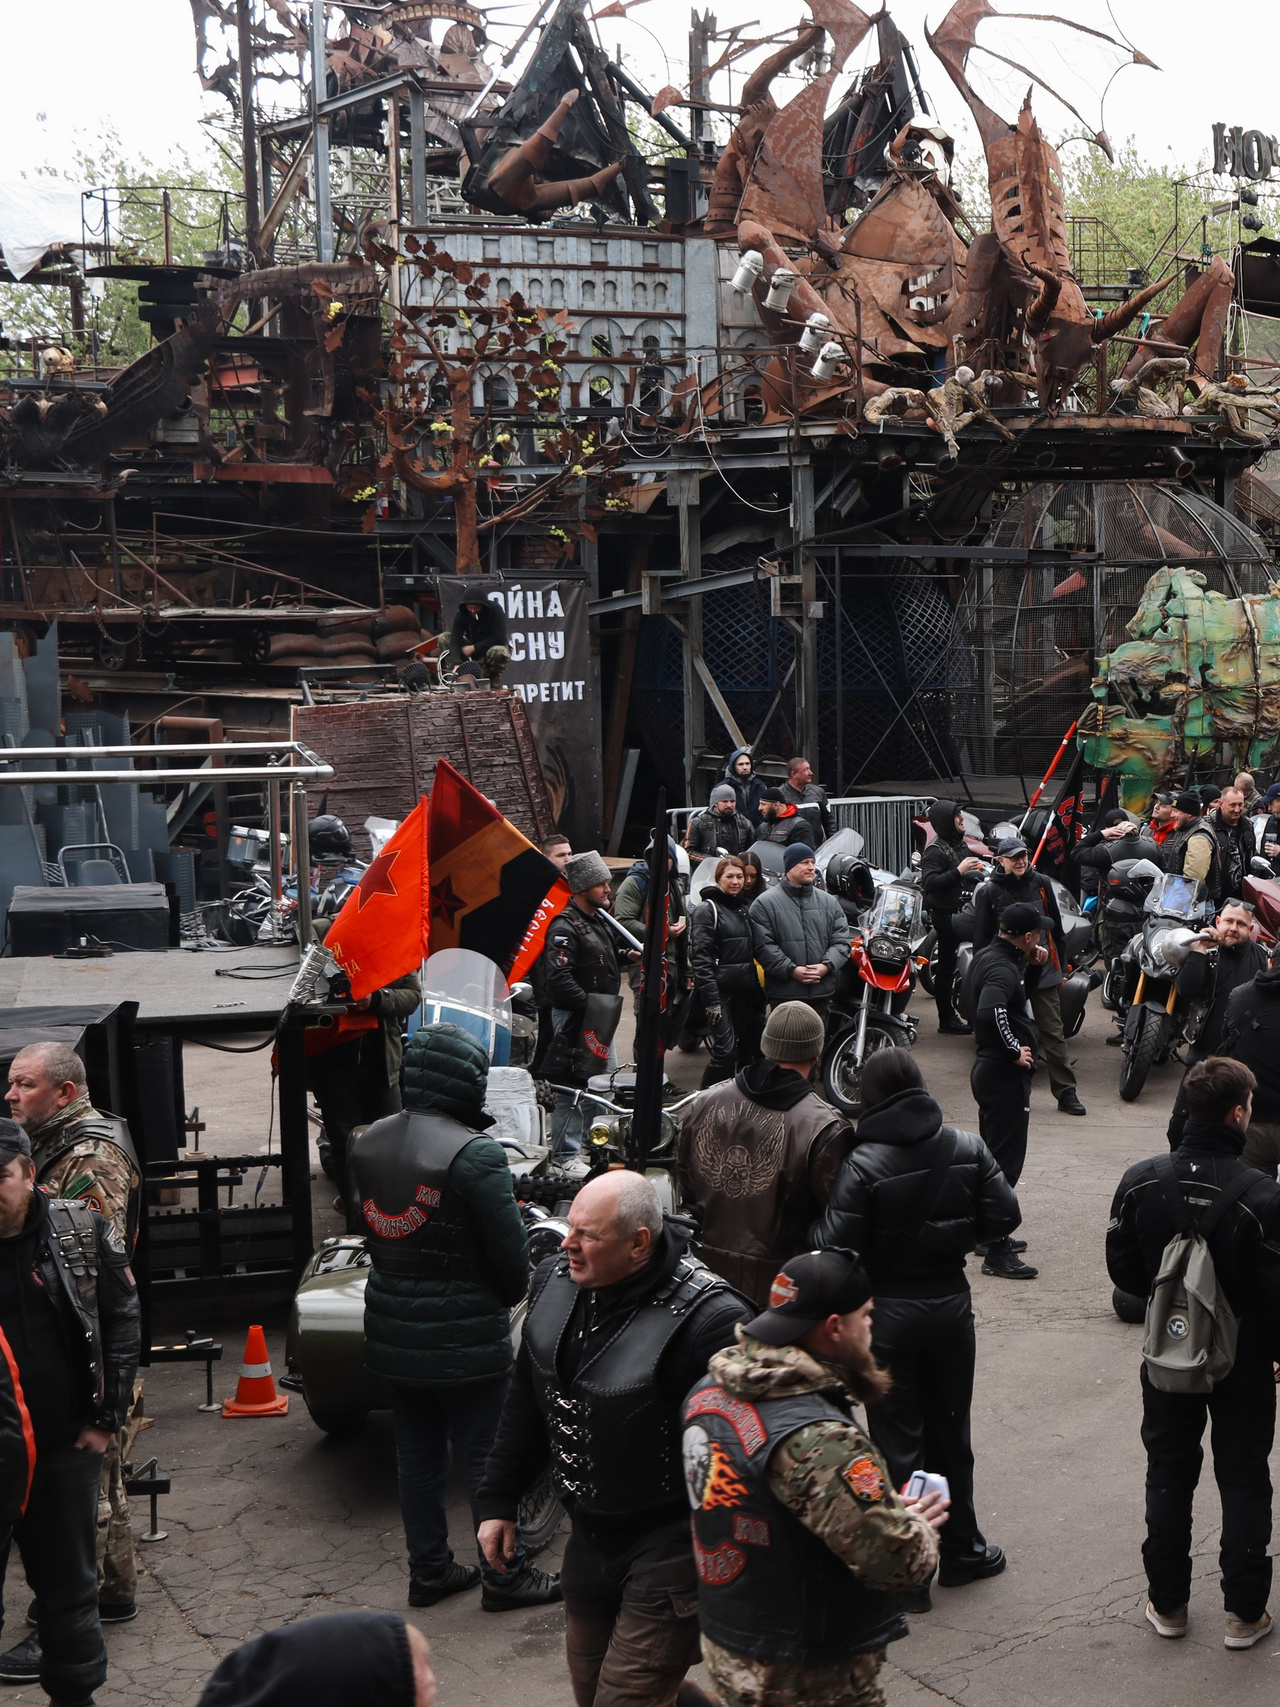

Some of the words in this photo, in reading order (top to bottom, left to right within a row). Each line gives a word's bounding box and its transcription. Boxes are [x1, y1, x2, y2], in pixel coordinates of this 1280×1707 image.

[487, 584, 565, 619] ОЙНА
[509, 631, 565, 661] СНУ
[502, 681, 586, 703] ПРЕТИТ
